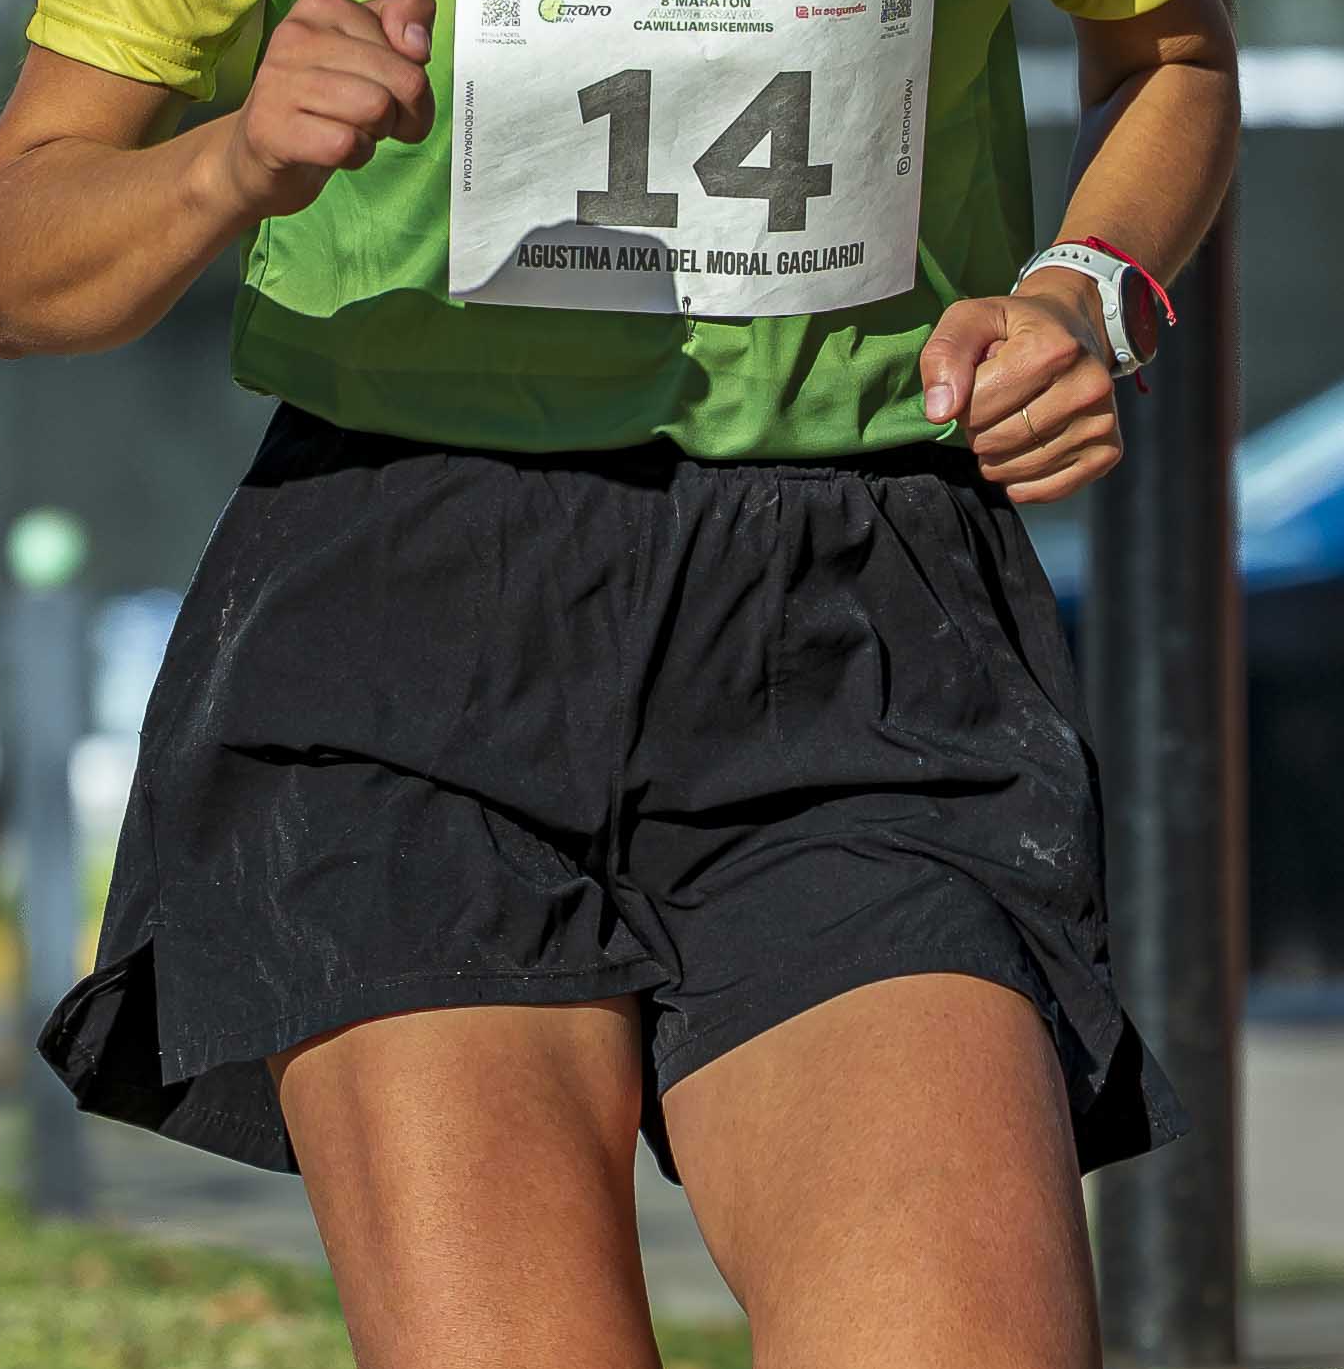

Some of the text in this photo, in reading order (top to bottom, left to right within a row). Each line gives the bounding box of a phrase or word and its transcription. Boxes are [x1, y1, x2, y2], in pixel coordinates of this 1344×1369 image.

[633, 20, 774, 33] CAWILLIAMSKEMMIS
[463, 80, 475, 192] WWW.CRONORAV.COM.AR
[575, 69, 833, 233] 14
[516, 241, 865, 276] AGUSTINA AIXA DEL MORAL GAGLIARDI
